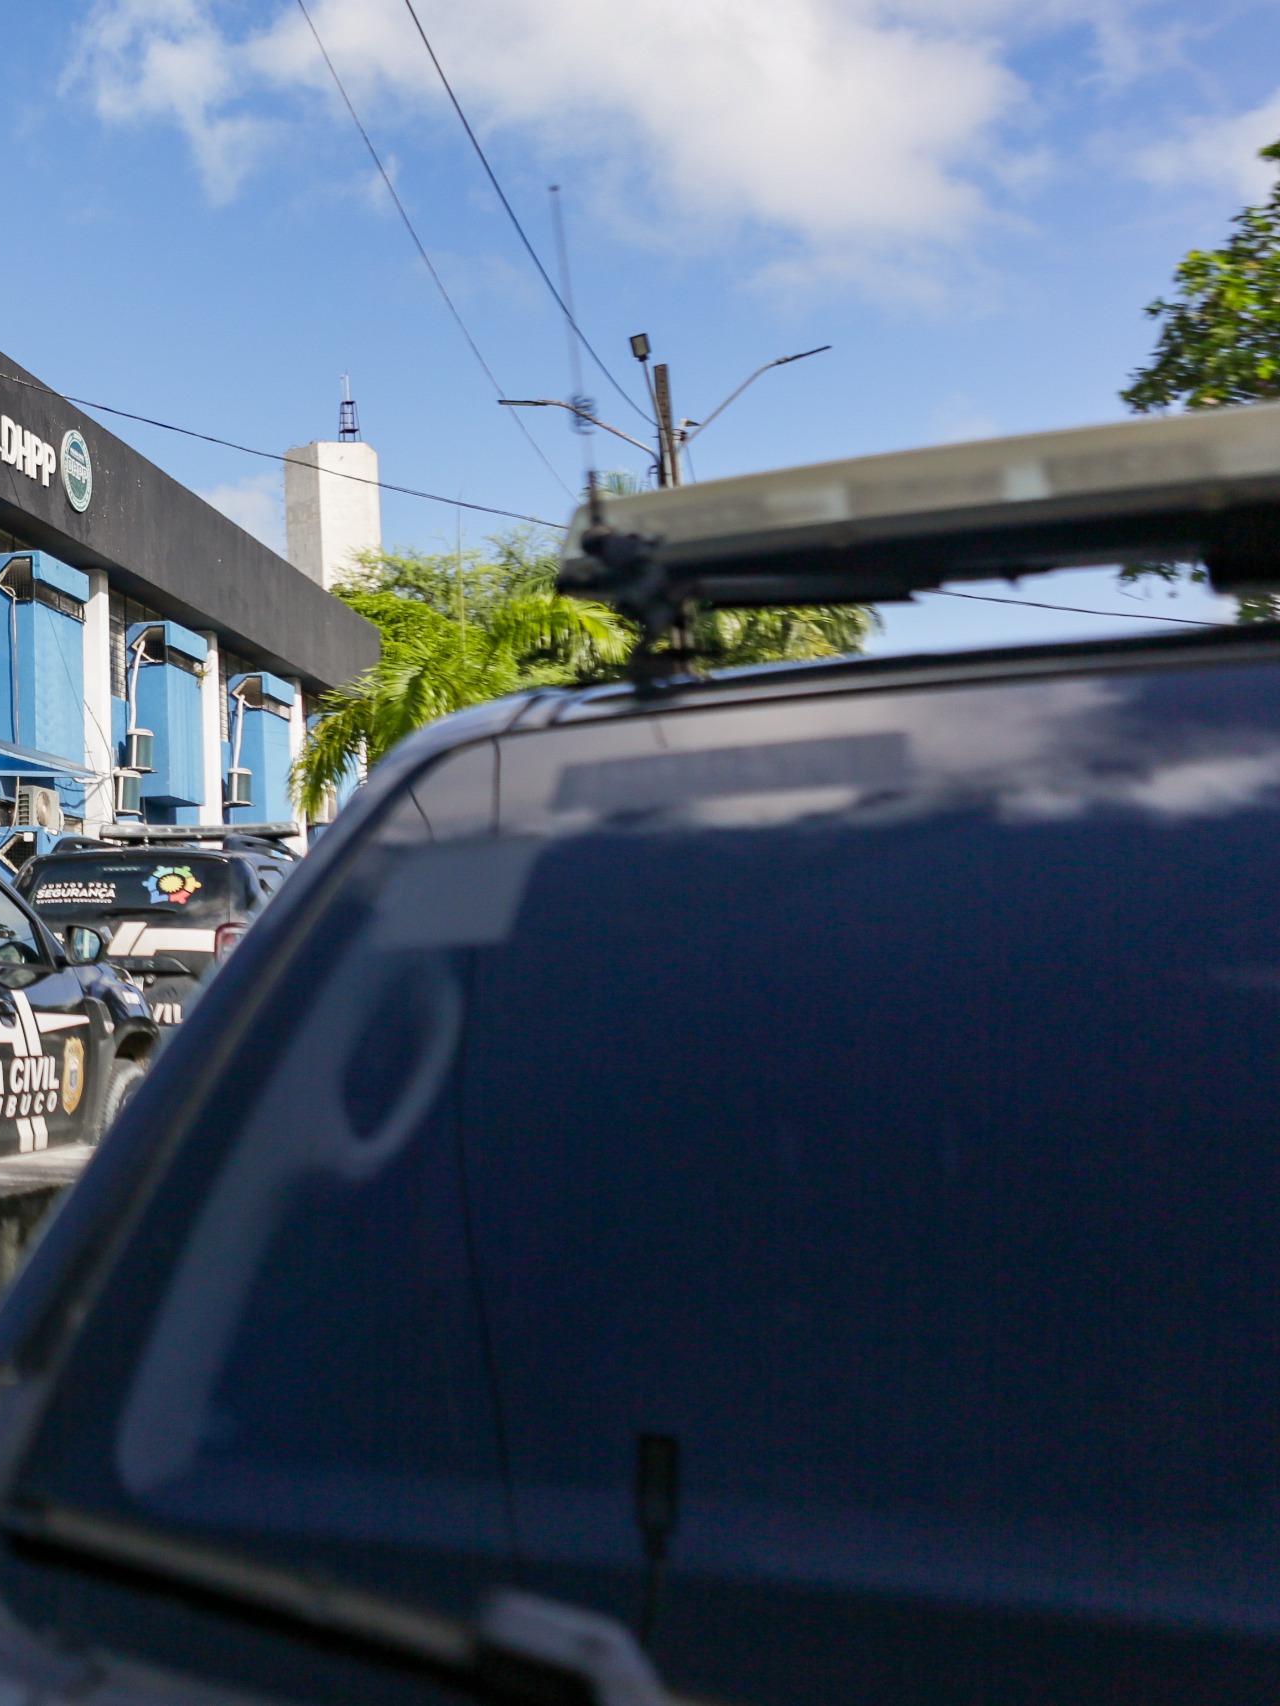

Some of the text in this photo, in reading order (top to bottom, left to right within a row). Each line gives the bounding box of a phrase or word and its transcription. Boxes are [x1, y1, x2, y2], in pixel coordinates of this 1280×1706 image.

[0, 414, 57, 488] DHPP
[36, 888, 116, 899] SEGURANÇA
[9, 1055, 60, 1094] CIVIL
